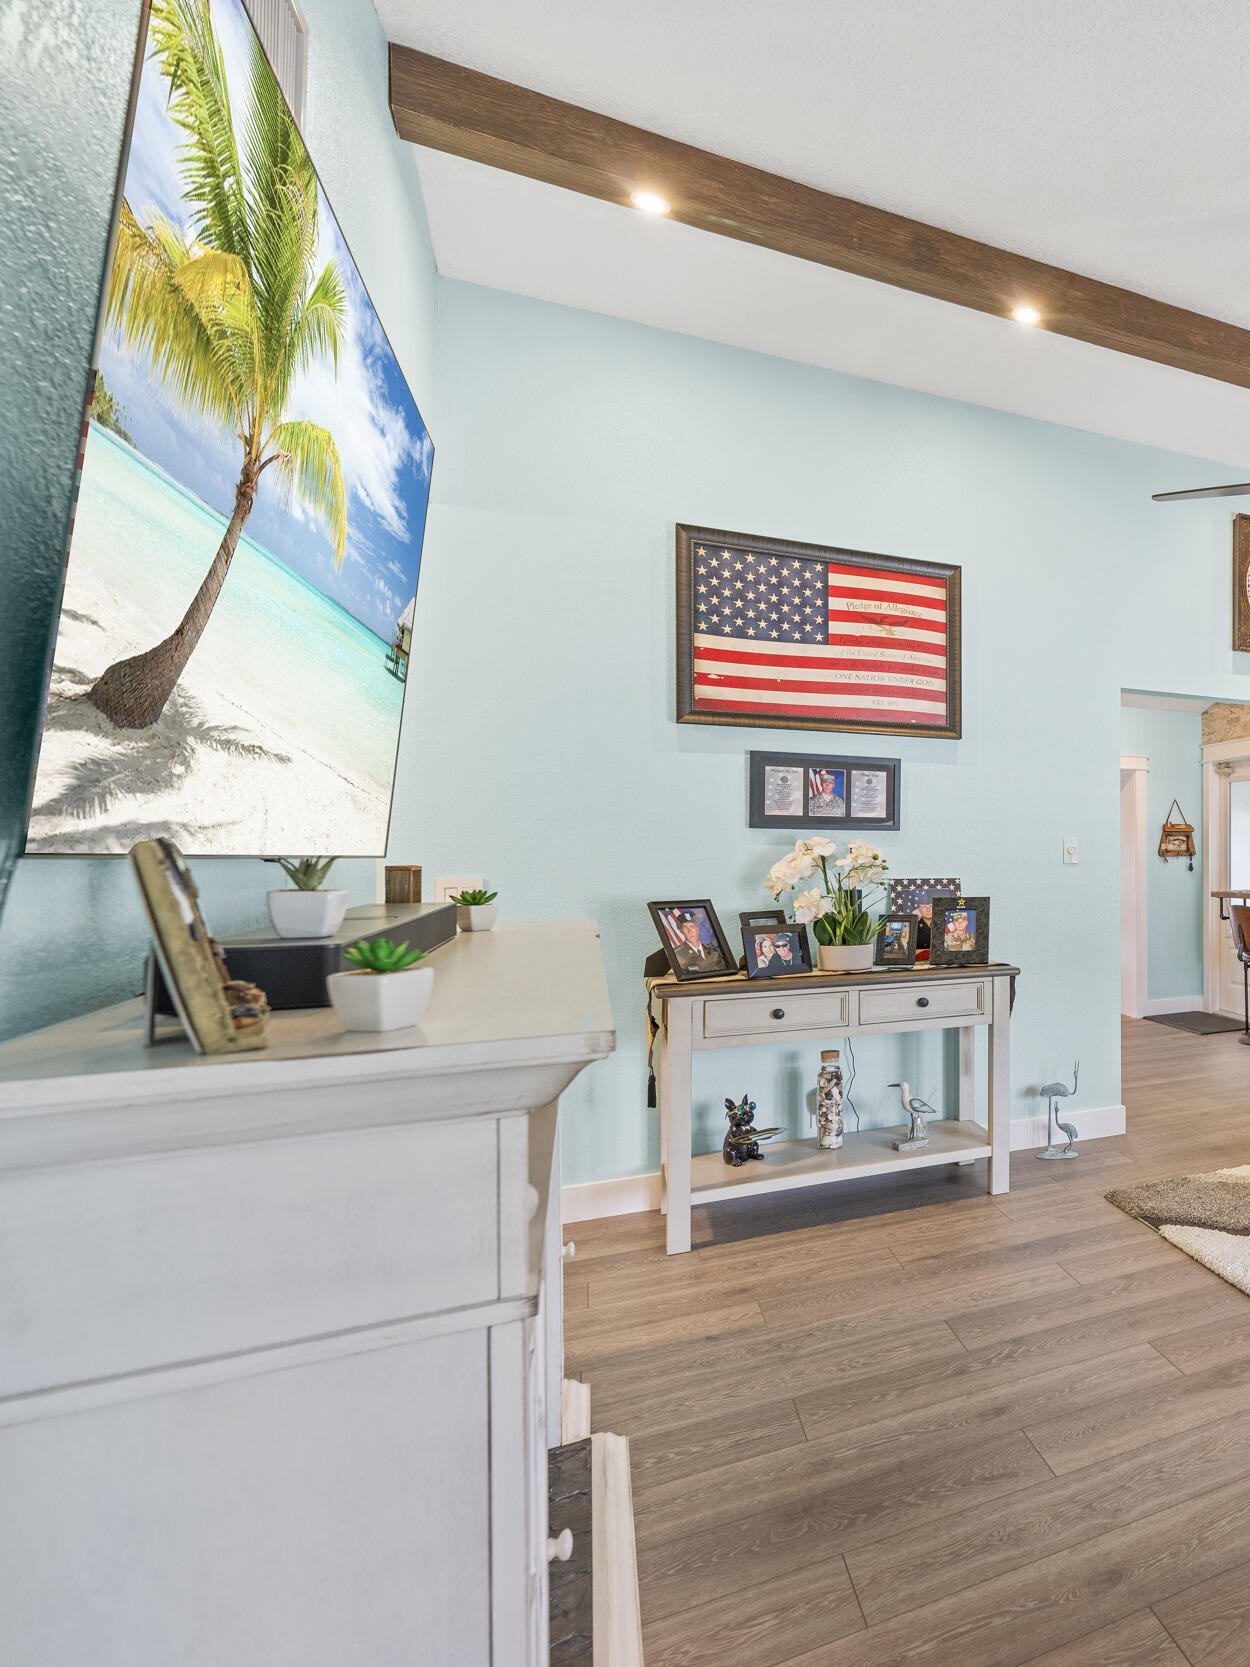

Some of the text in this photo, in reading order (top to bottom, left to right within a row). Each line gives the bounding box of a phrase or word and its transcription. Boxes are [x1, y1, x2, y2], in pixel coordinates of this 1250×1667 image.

[845, 601, 872, 610] Pledge
[873, 602, 883, 610] of
[834, 672, 853, 680] ONE
[854, 673, 886, 682] NATION
[887, 675, 914, 685] UNDER
